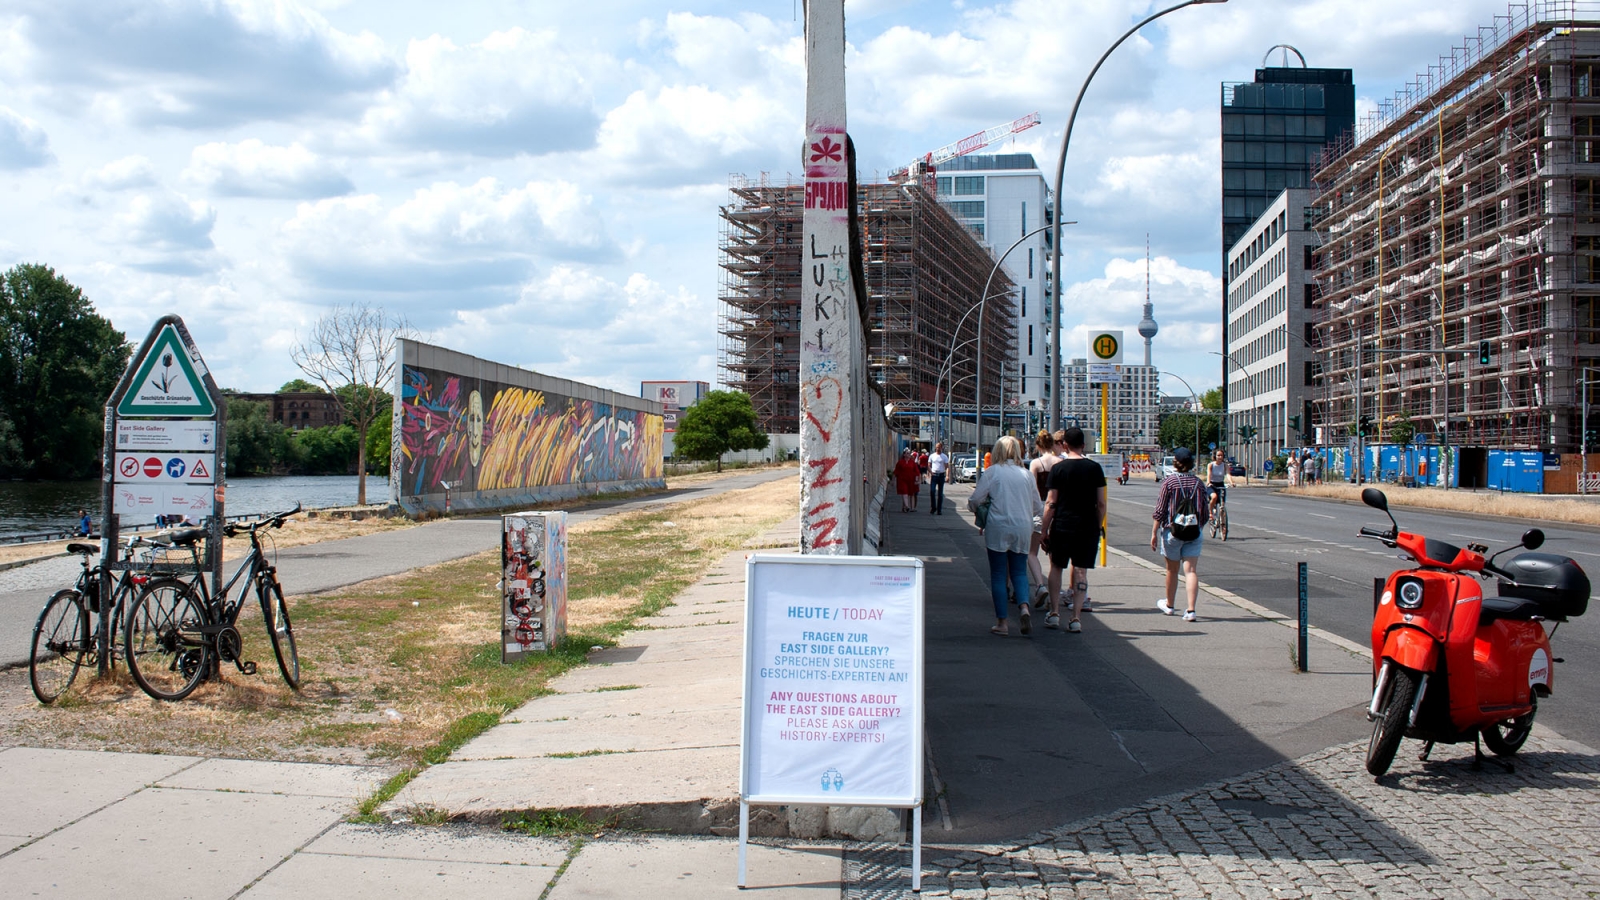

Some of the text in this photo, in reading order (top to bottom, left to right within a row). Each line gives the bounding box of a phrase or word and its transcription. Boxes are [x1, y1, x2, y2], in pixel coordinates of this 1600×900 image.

[788, 606, 884, 621] HEUTE / TODAY
[802, 631, 868, 643] FRAGEN ZUR
[780, 643, 890, 656] EAST SIDE GALLERY?
[774, 655, 895, 669] SPRECHEN SIE UNSERE
[760, 668, 908, 683] GESCHICHTS-EXPERTEN AN!
[770, 691, 897, 705] ANY QUESTIONS ABOUT
[766, 703, 901, 718] THE EAST SIDE GALLERY?
[787, 717, 880, 730] PLEASE ASK OUR
[780, 730, 885, 743] HISTORY-EXPERTS!
